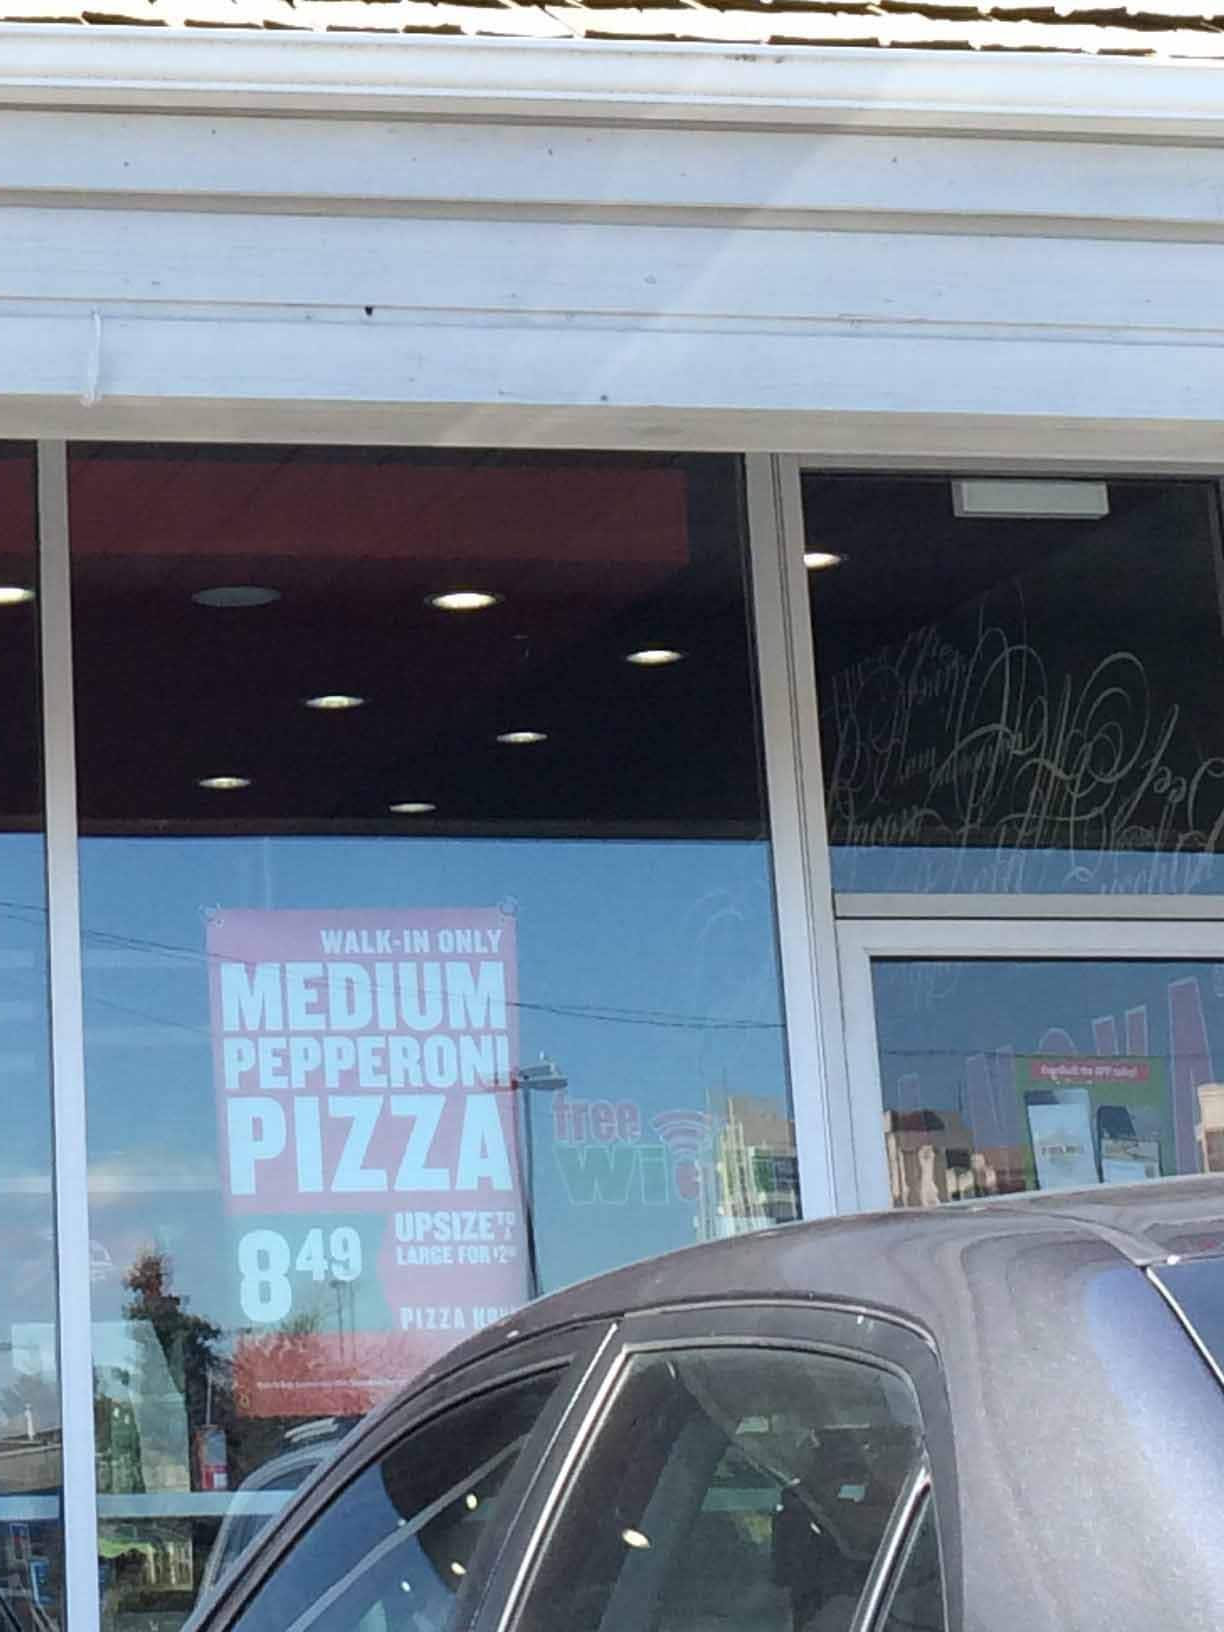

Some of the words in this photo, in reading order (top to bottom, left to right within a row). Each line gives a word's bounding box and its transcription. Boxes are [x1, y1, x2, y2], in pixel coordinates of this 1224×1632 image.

[320, 929, 430, 954] WALK-IN
[438, 928, 504, 953] ONLY
[221, 960, 508, 1032] MEDIUM
[223, 1033, 511, 1089] PEPPERONI
[552, 1092, 641, 1144] free
[227, 1093, 514, 1196] PIZZA
[394, 1210, 495, 1243] UPSIZE
[396, 1245, 454, 1265] LARGE
[457, 1244, 491, 1265] FOR
[400, 1306, 466, 1330] PIZZA
